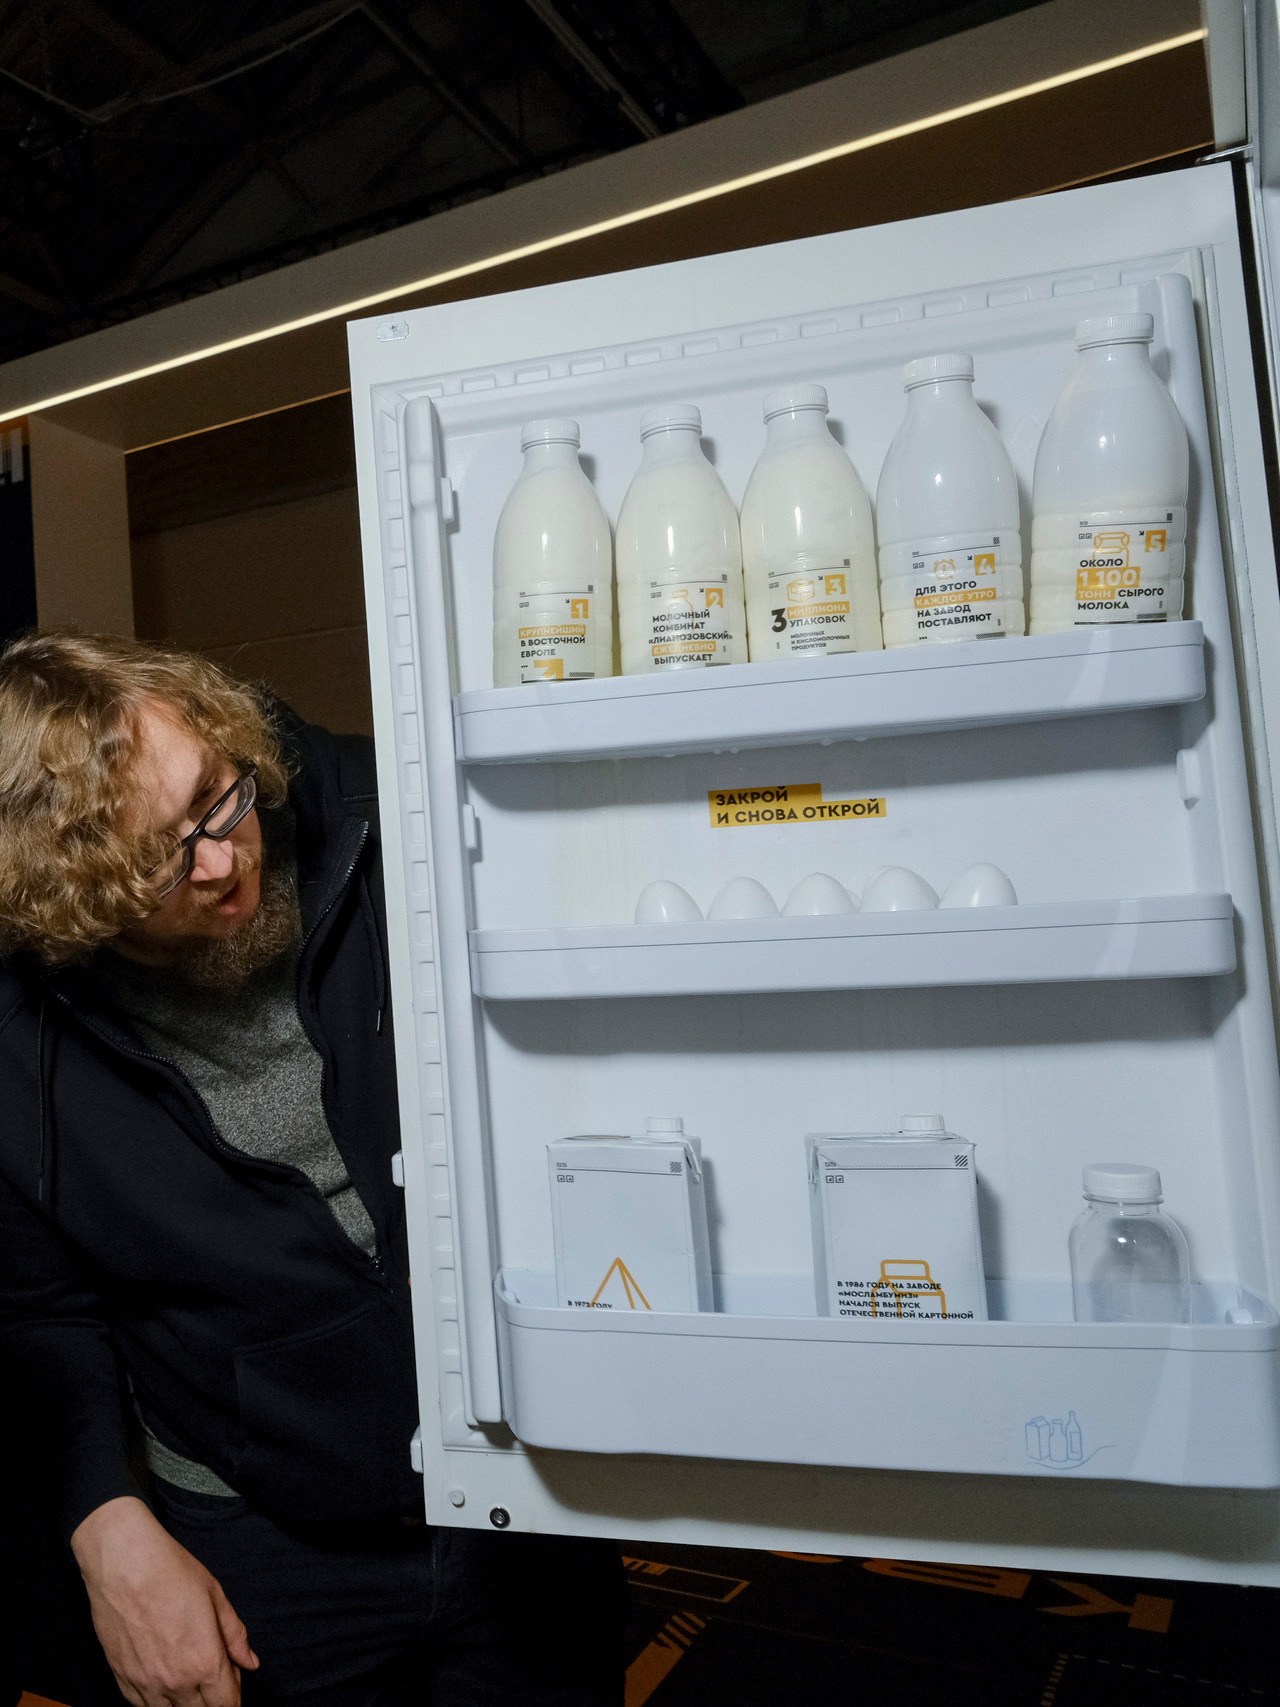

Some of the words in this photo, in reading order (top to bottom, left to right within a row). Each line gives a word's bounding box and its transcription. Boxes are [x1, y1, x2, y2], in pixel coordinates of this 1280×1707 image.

[1080, 558, 1123, 567] ОКОЛО
[915, 586, 936, 597] ДЛЯ
[940, 581, 977, 592] ЭТОГО
[1078, 590, 1111, 598] ТОНН
[1118, 588, 1164, 597] СЫРОГО
[917, 593, 964, 606] КАЖДОЕ
[967, 590, 994, 600] УТРО
[917, 609, 931, 618] НА
[933, 604, 971, 616] ЗАВОД
[1078, 601, 1129, 610] МОЛОКА
[652, 609, 710, 622] МОЛОЧНЫЙ
[771, 607, 787, 633] 3
[789, 604, 847, 617] МИЛЛИОНА
[789, 615, 846, 627] УПАКОВОК
[918, 613, 992, 629] ПОСТАВЛЯЮТ
[520, 625, 585, 637] КРУПНЕЙШИЙ
[653, 622, 705, 633] КОМБИНАТ
[528, 635, 586, 646] ВОСТОЧНОЙ
[648, 631, 733, 644] «ЛИАНОЗОВСКИЙ»
[790, 631, 825, 639] МОЛОЧНЫХ
[796, 634, 850, 644] КИСЛОМОЛОЧНЫХ
[654, 643, 715, 654] ЕЖЕДНЕВНО
[791, 642, 827, 651] ПРОДУКТОВ
[521, 649, 556, 658] ЕВРОПЕ
[654, 654, 713, 665] ВЫПУСКАЕТ
[716, 786, 788, 806] ЗАКРОЙ
[717, 812, 729, 824] И
[735, 807, 798, 823] СНОВА
[802, 798, 880, 818] ОТКРОЙ
[838, 1291, 918, 1299] «МОСЛАМБУМИЗ»
[839, 1300, 880, 1308] НАЧАЛСЯ
[882, 1301, 921, 1309] ВЫПУСК
[839, 1309, 915, 1318] ОТЕЧЕСТВЕННОЙ
[918, 1311, 974, 1319] КАРТОННОЙ
